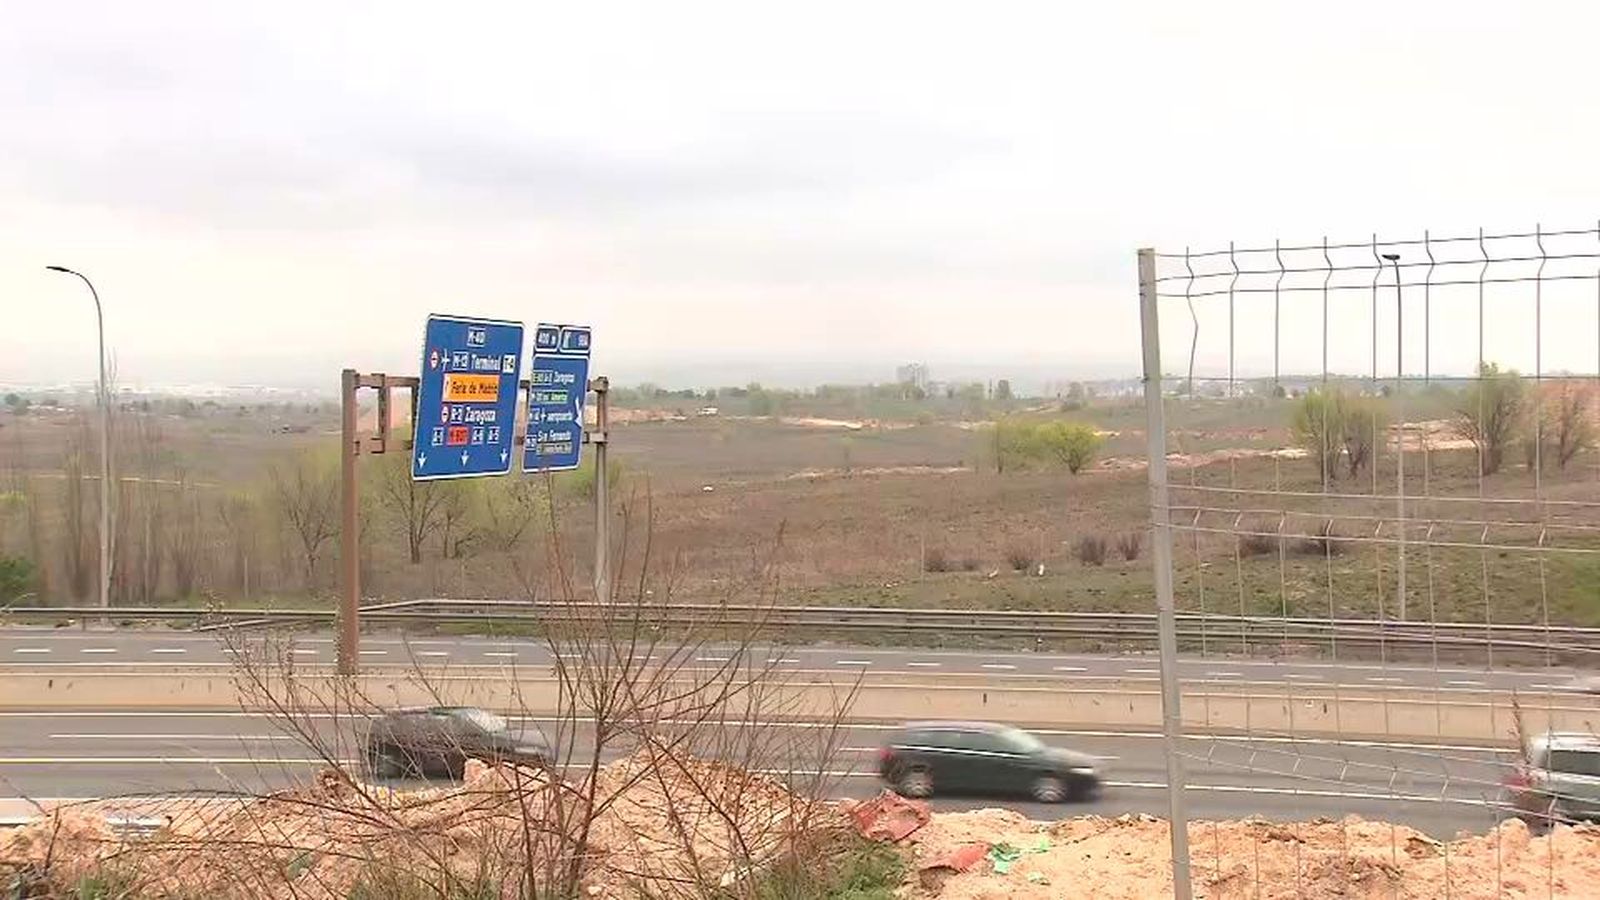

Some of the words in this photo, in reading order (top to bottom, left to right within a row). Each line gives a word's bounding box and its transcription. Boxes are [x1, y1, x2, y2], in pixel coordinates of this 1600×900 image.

[471, 353, 501, 371] Terminal
[452, 380, 466, 395] Feria
[469, 381, 477, 394] de
[478, 383, 498, 395] Madrid
[465, 406, 497, 425] Zaragoza
